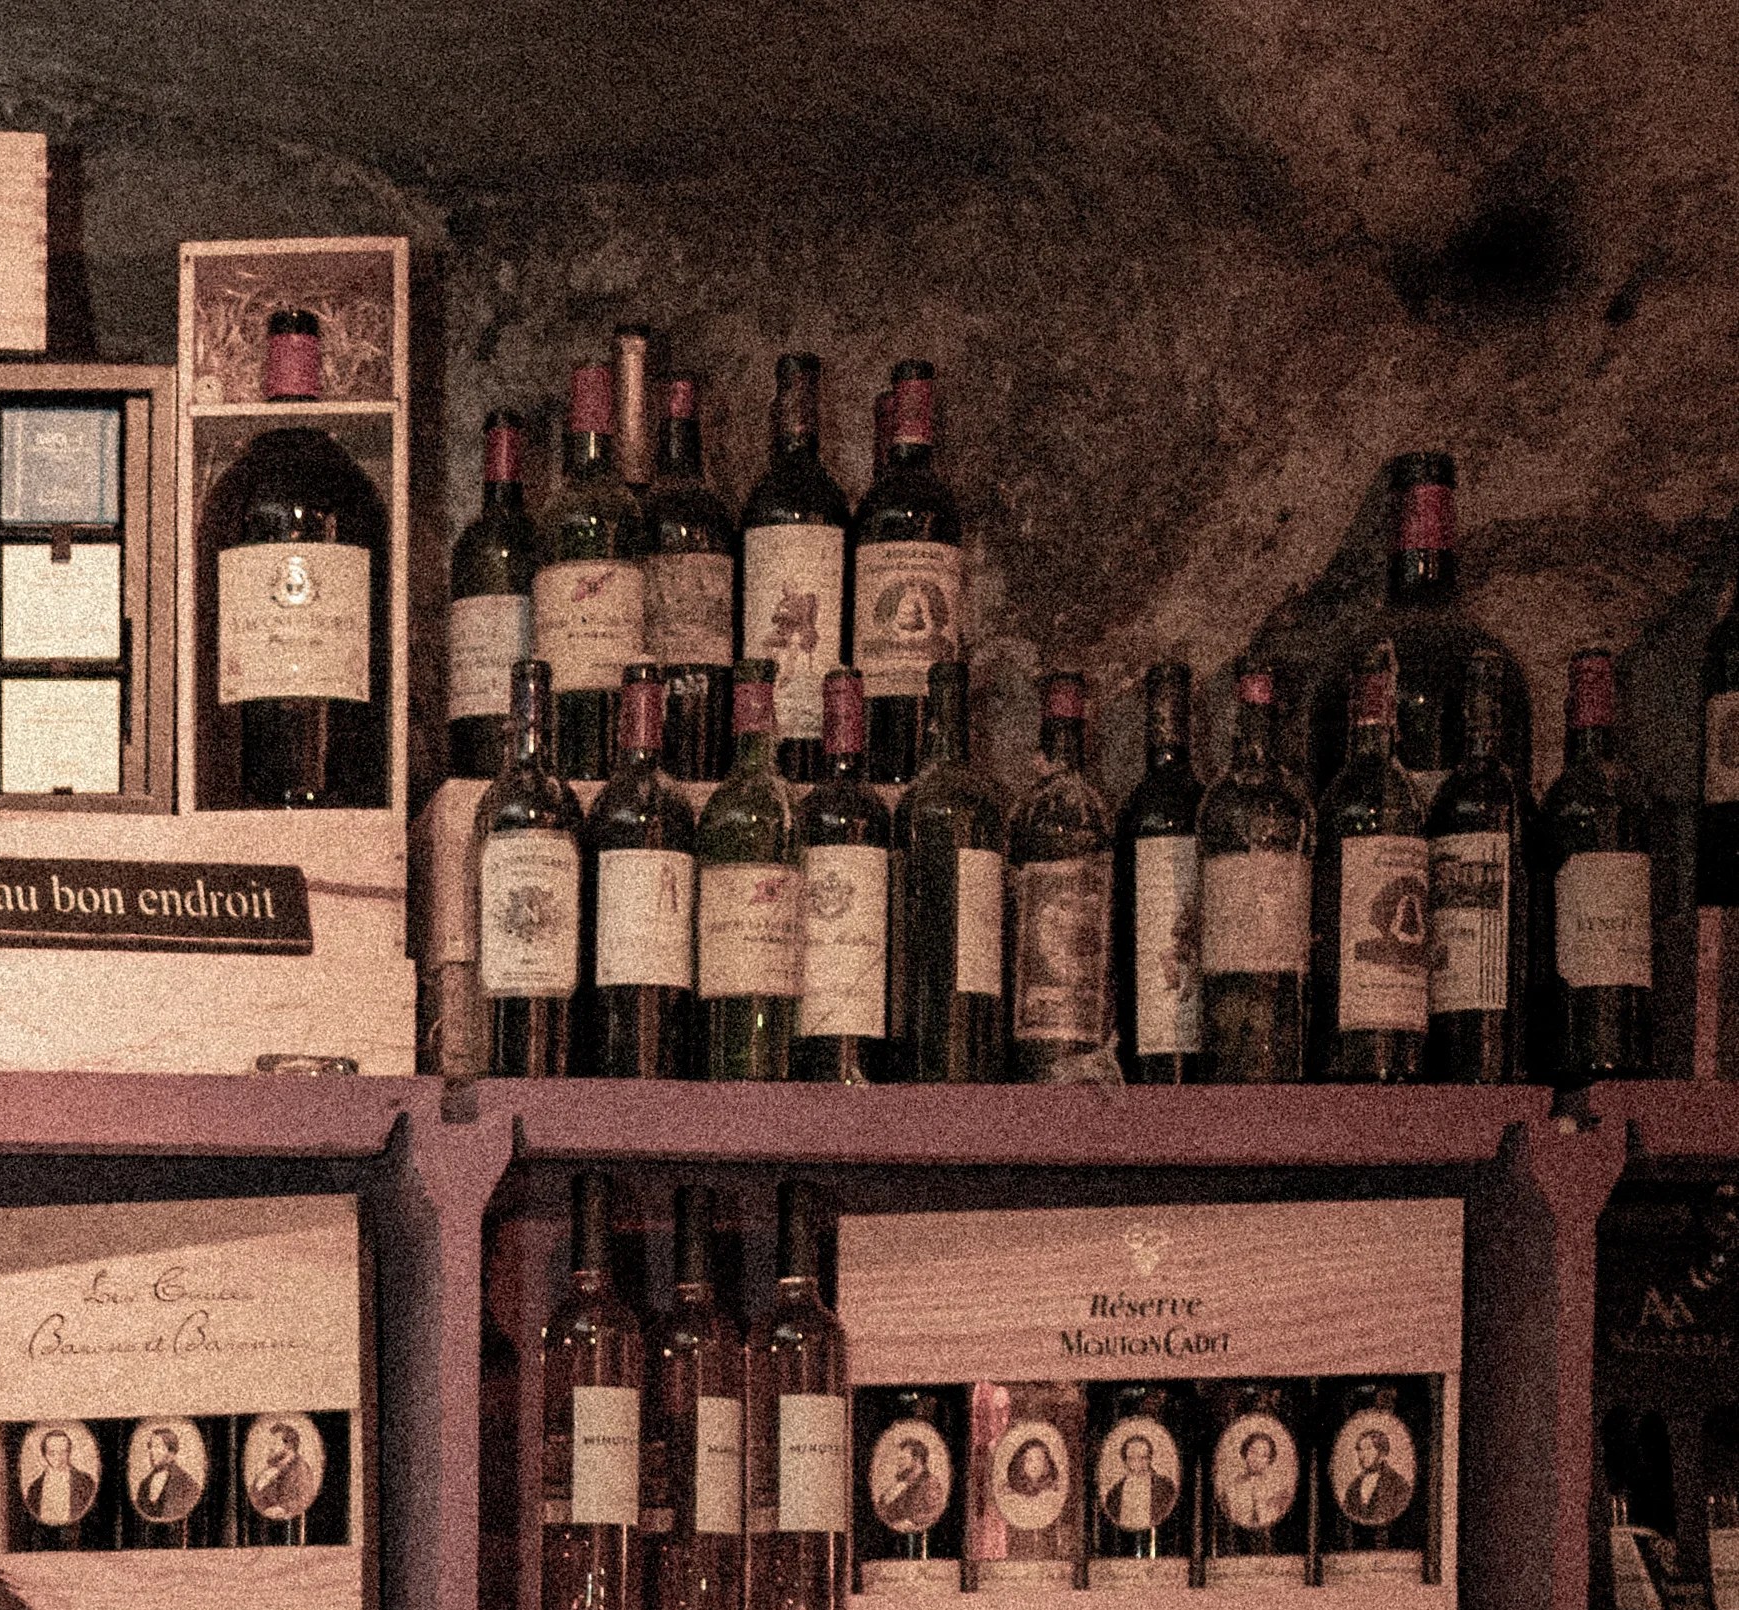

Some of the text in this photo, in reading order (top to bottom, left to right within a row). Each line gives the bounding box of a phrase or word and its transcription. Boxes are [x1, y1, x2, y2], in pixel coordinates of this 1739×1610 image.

[50, 874, 127, 916] bon
[137, 879, 277, 920] endroit
[1089, 1291, 1204, 1318] Réserve
